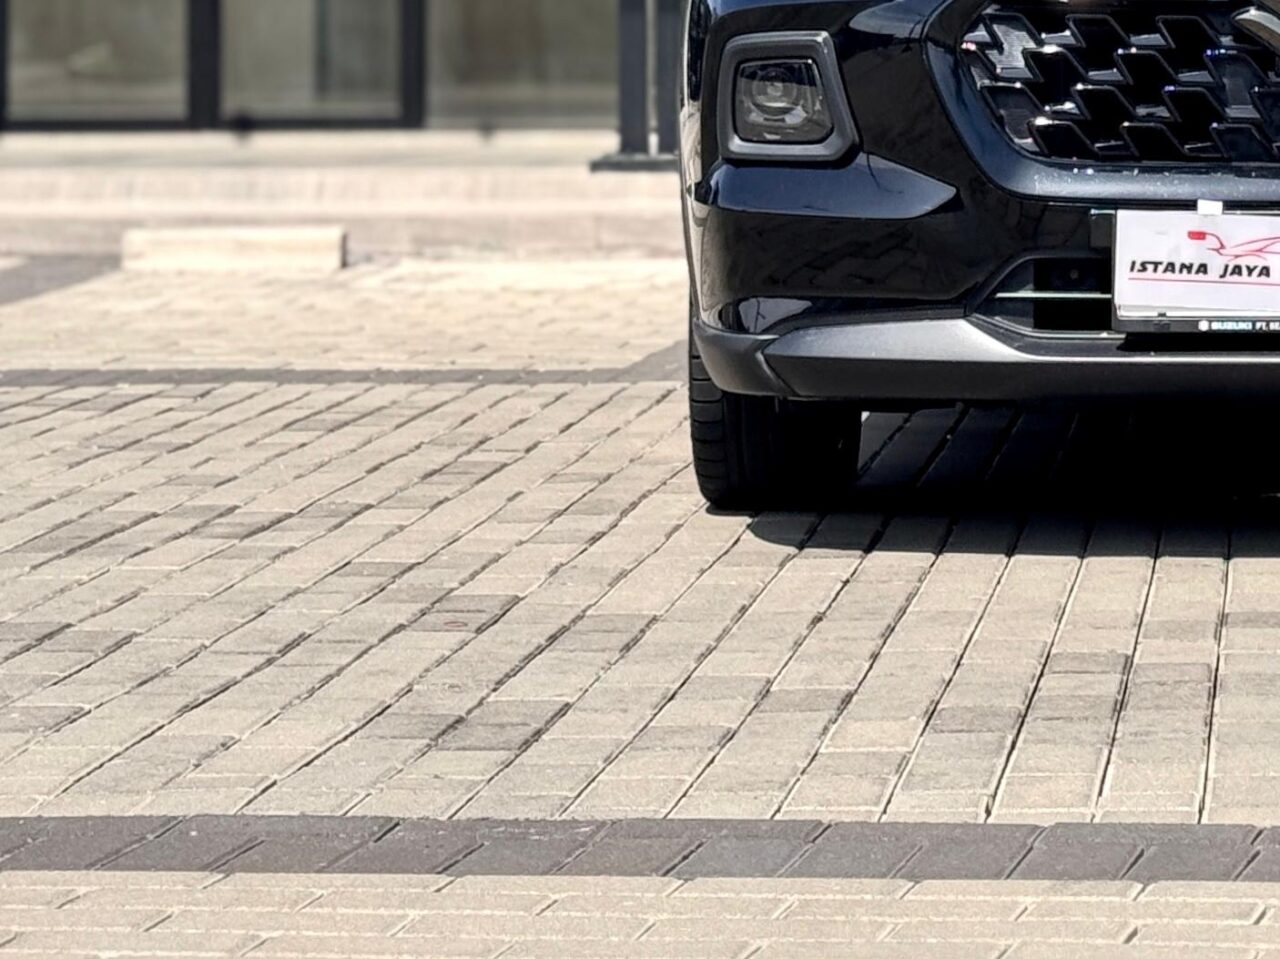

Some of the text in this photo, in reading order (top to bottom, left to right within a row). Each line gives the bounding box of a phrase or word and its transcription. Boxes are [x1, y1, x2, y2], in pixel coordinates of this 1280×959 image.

[1129, 260, 1209, 275] ISTANA
[1219, 263, 1271, 279] JAYA
[1210, 320, 1253, 331] SUZUKI
